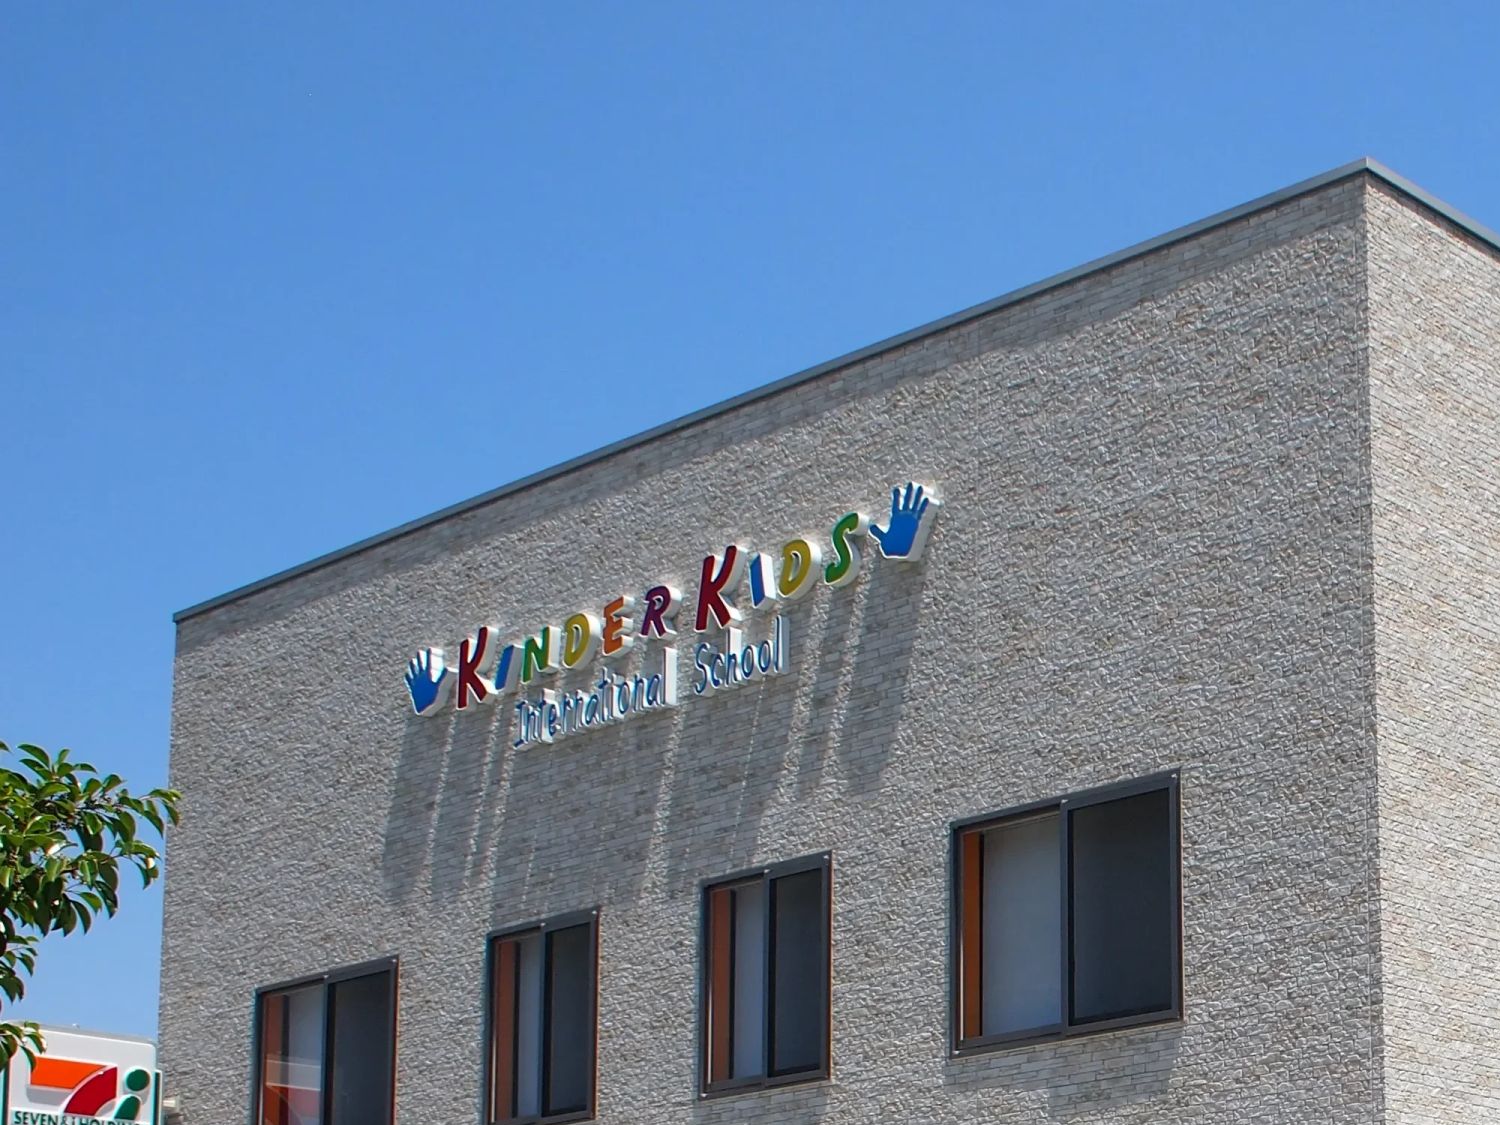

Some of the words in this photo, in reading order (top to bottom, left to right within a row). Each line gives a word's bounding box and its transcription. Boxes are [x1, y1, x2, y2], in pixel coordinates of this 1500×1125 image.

[456, 584, 678, 710] KINDER
[694, 512, 866, 632] KIDS
[513, 647, 676, 749] International
[694, 615, 786, 694] School
